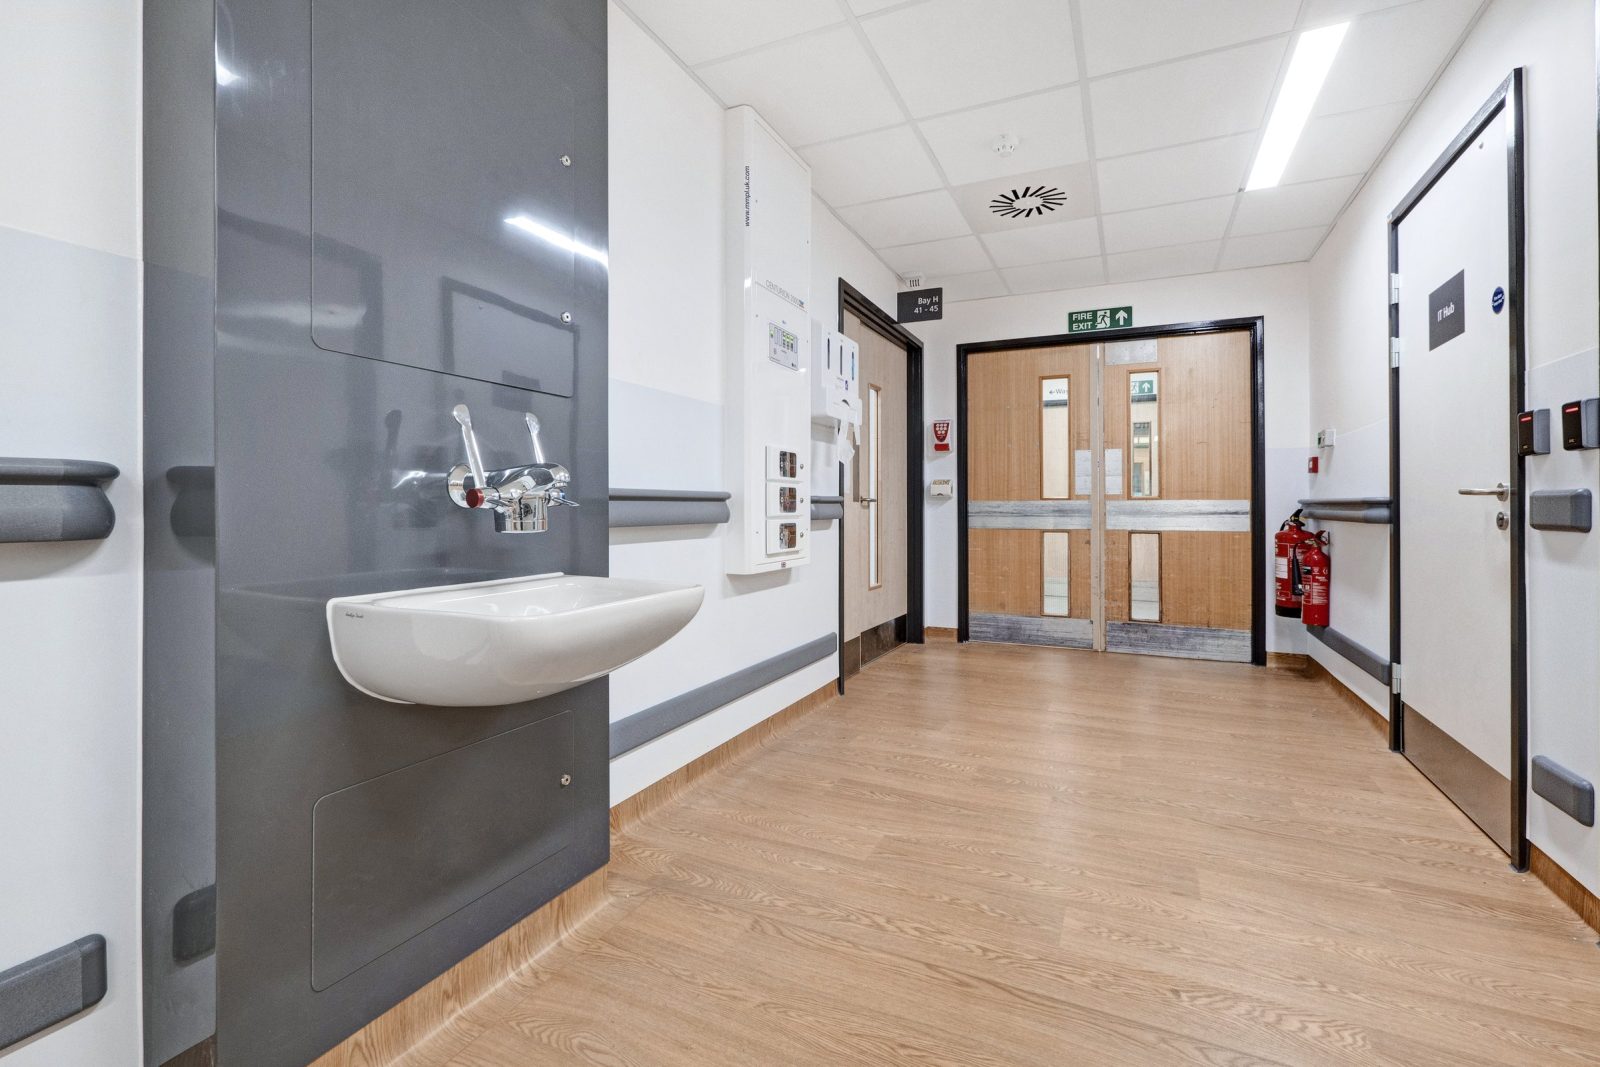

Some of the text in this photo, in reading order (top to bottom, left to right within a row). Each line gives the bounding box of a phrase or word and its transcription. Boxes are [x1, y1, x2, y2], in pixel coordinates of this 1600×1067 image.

[917, 295, 939, 306] Bay H
[929, 304, 939, 313] 45
[1437, 301, 1455, 323] IT Hub
[1072, 312, 1093, 321] FIRE
[1072, 321, 1093, 331] EXIT
